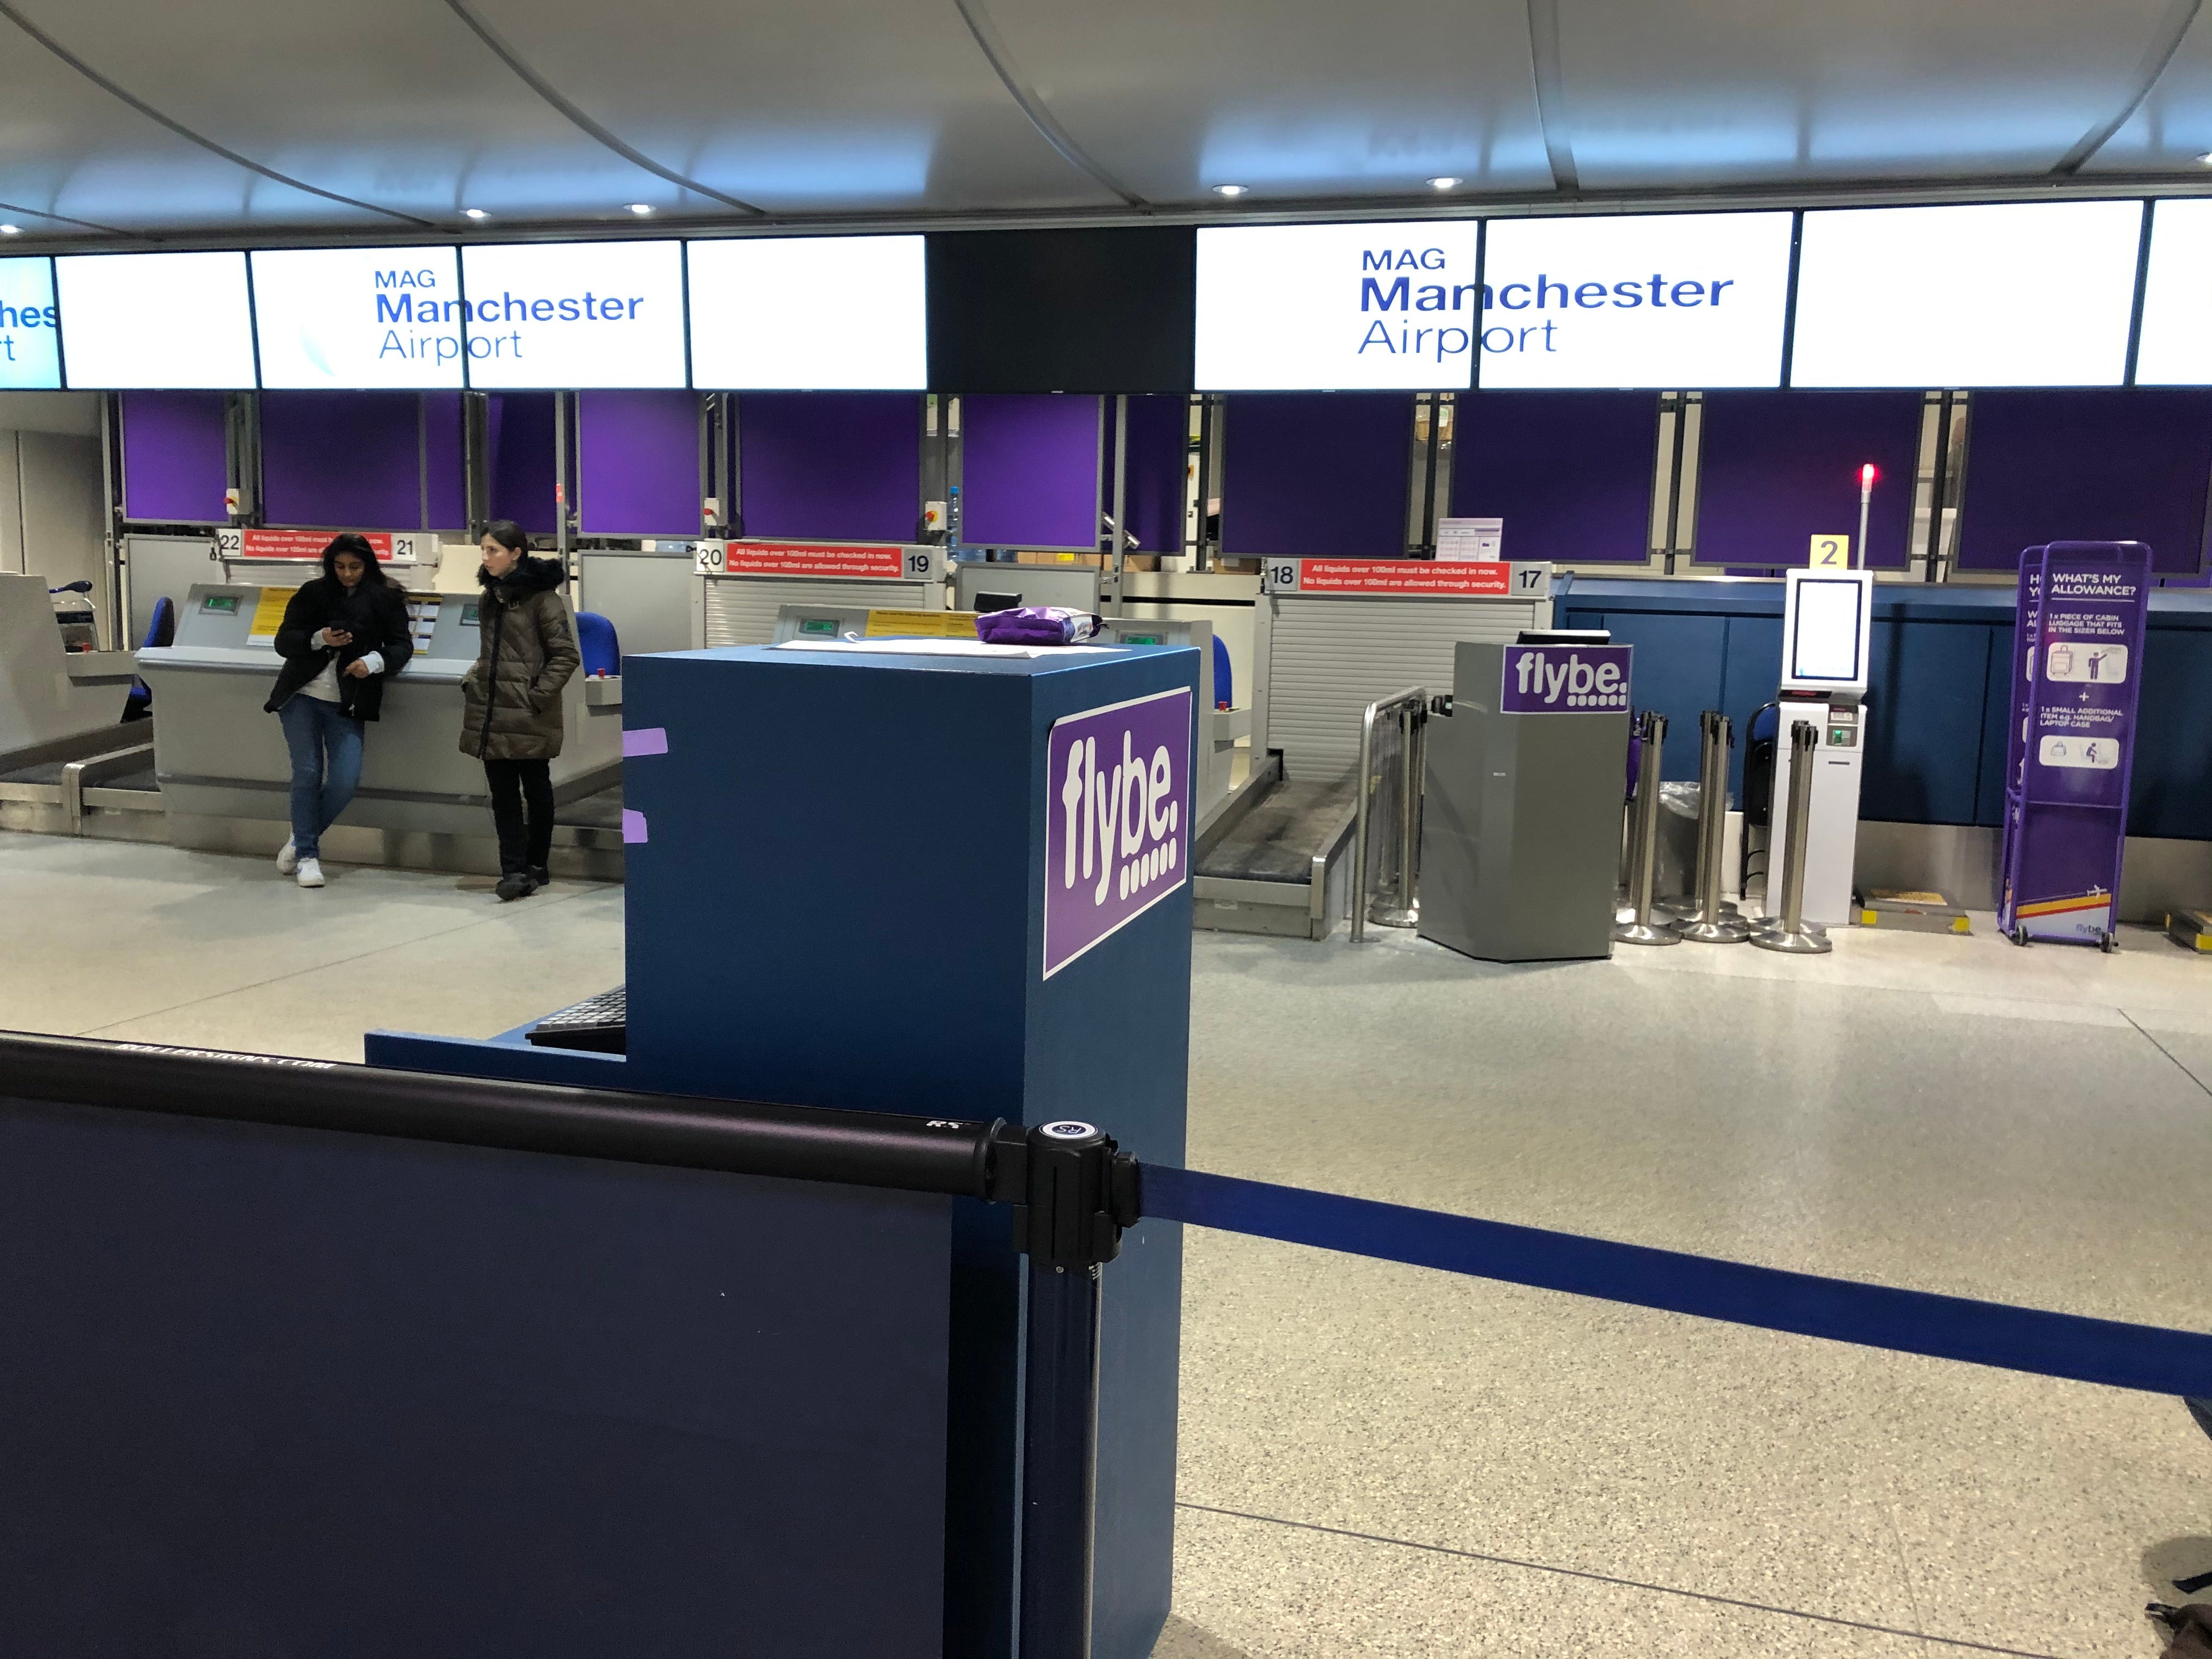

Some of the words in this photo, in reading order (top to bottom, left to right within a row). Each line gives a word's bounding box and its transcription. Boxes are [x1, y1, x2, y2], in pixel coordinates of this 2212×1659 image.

[1363, 248, 1446, 270] MAG
[375, 269, 436, 289] MAG
[1361, 274, 1734, 312] Manchester
[376, 292, 644, 323] Manchester
[380, 330, 523, 366] Airport
[1358, 319, 1558, 363] Airport
[221, 534, 239, 550] 22
[397, 540, 413, 555] 21
[699, 549, 723, 566] 20
[1820, 540, 1838, 565] 2
[740, 560, 762, 568] liquids
[842, 563, 869, 572] through
[908, 555, 929, 573] 19
[1324, 565, 1350, 573] liquids
[1271, 566, 1294, 584] 18
[1317, 577, 1342, 586] liquids
[1403, 579, 1435, 587] allowed
[1437, 580, 1469, 589] through
[1471, 580, 1506, 590] security.
[1519, 570, 1542, 589] 17
[2053, 573, 2099, 584] WHAT'S
[2102, 574, 2121, 584] MY
[2051, 584, 2136, 596] ALLOWANCE?
[2073, 714, 2115, 723] HANDBAG/
[2078, 707, 2123, 716] ADDITIONAL
